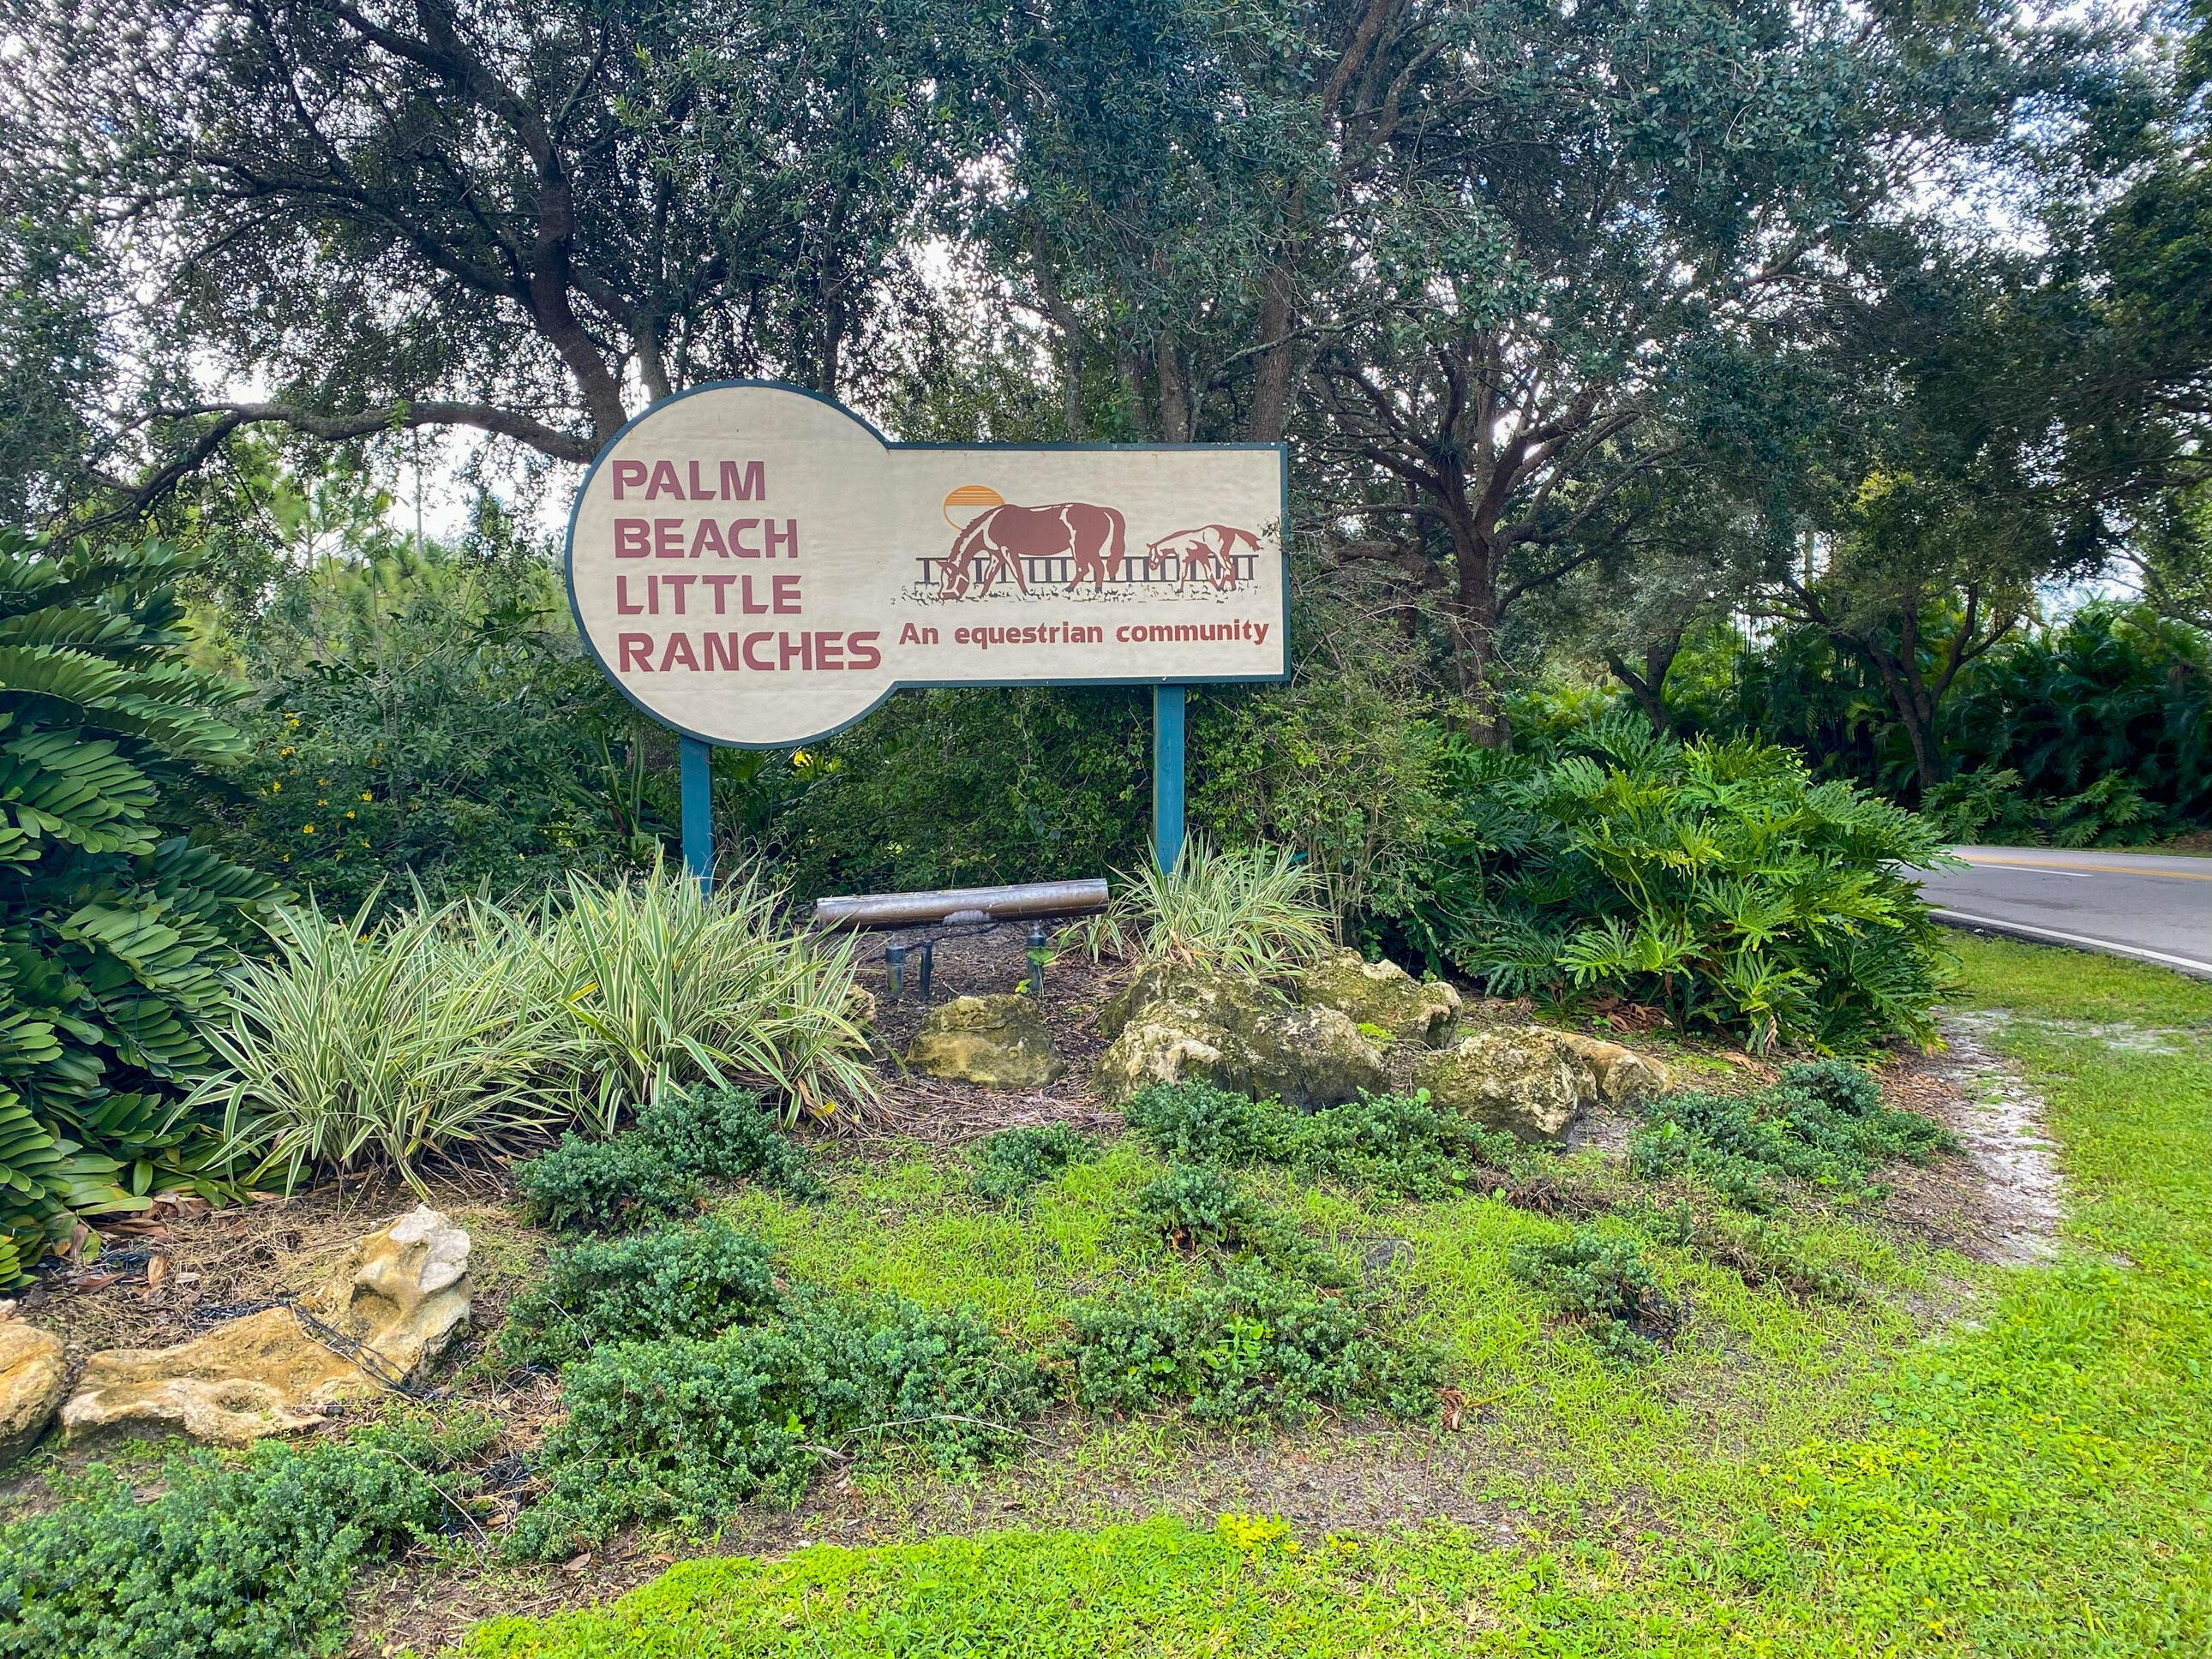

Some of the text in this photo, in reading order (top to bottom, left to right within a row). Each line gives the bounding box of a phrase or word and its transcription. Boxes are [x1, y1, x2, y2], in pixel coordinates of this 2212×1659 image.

[612, 460, 765, 500] PALM
[614, 518, 798, 558] BEACH
[616, 575, 801, 615] LITTLE
[619, 631, 882, 672] RANCHES
[899, 619, 1269, 650] An equestrian community
